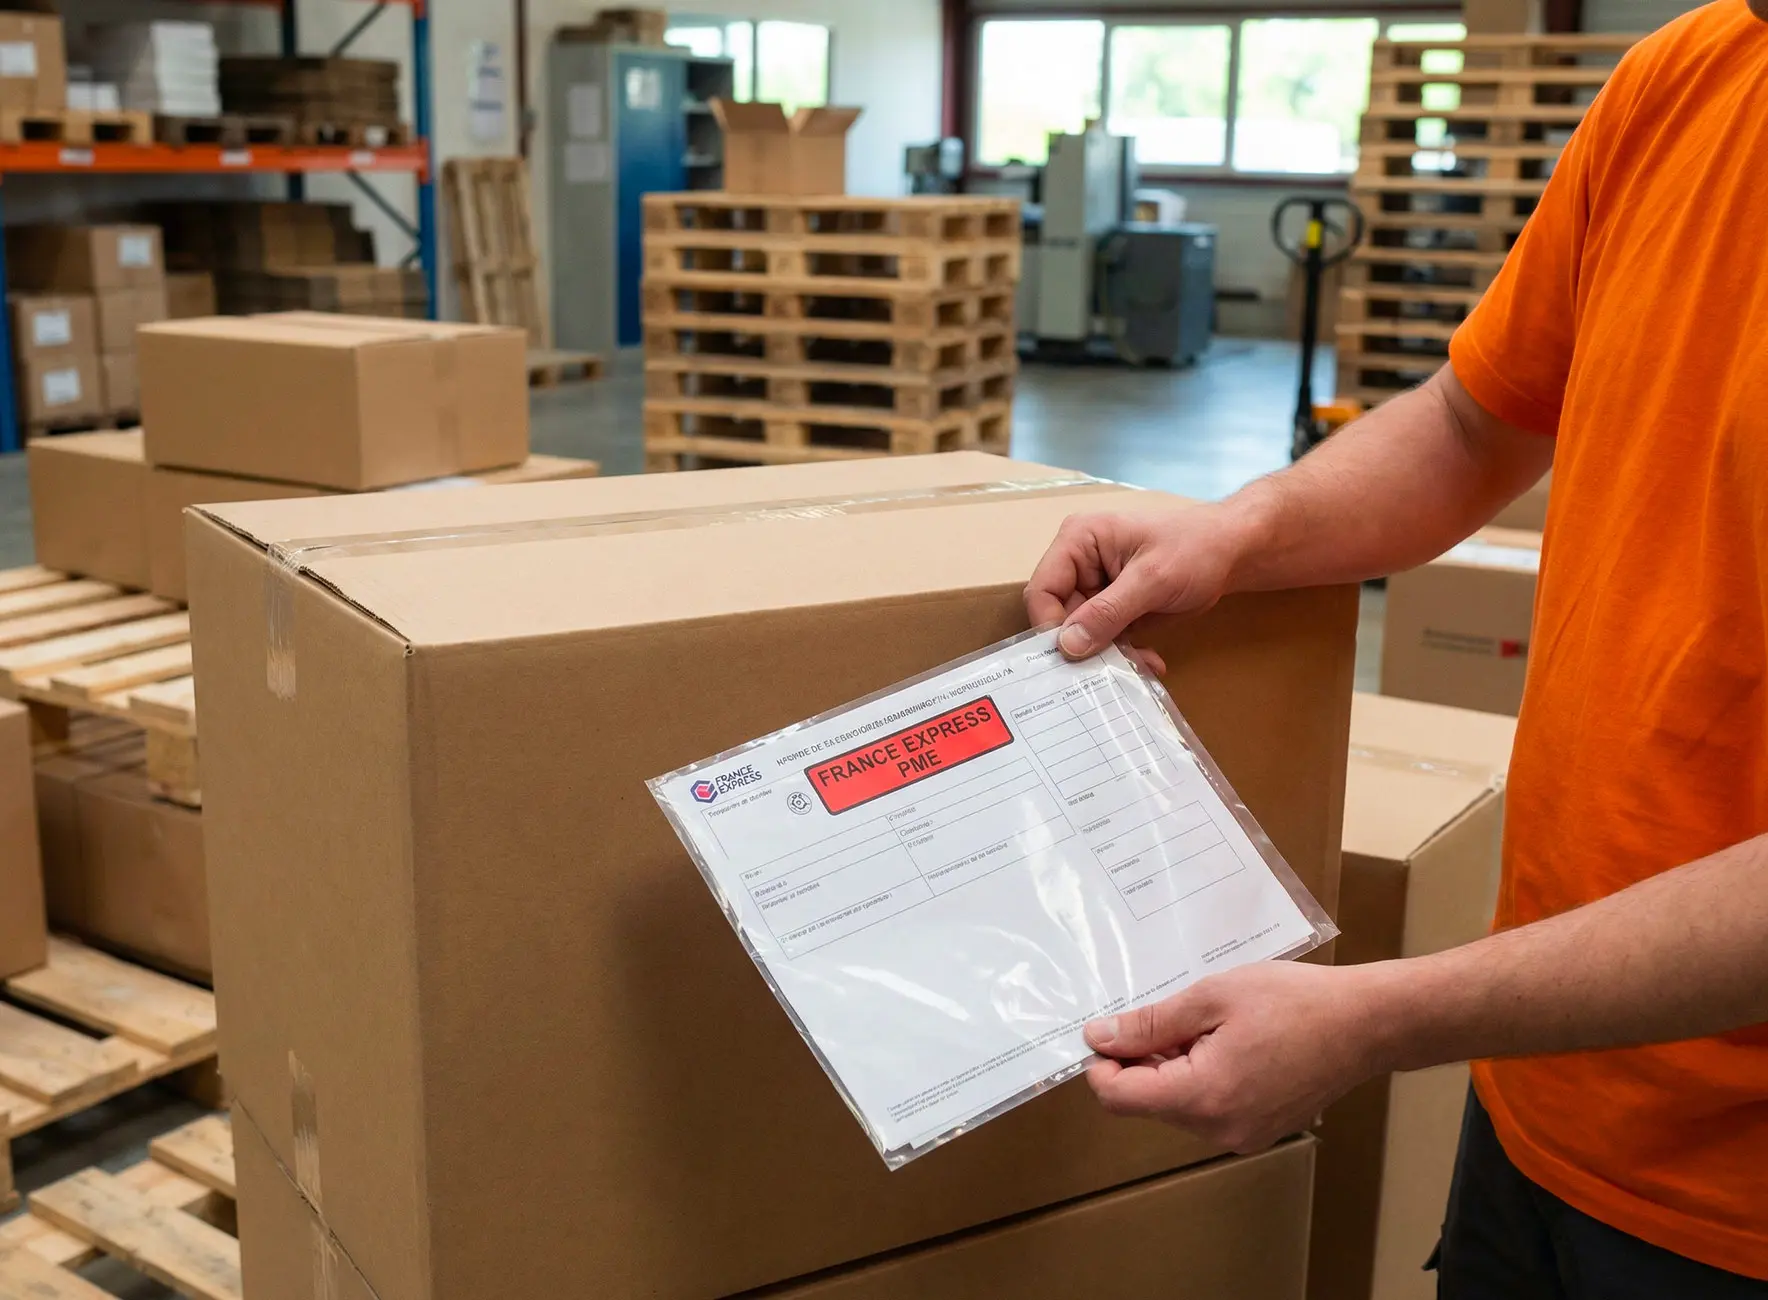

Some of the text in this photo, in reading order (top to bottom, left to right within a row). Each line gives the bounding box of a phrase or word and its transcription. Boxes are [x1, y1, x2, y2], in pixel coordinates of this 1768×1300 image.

[817, 743, 901, 787] FRANCE
[901, 706, 992, 753] EXPRESS
[715, 764, 754, 786] FRANCE
[897, 749, 942, 778] PME
[718, 771, 763, 794] EXPRESS
